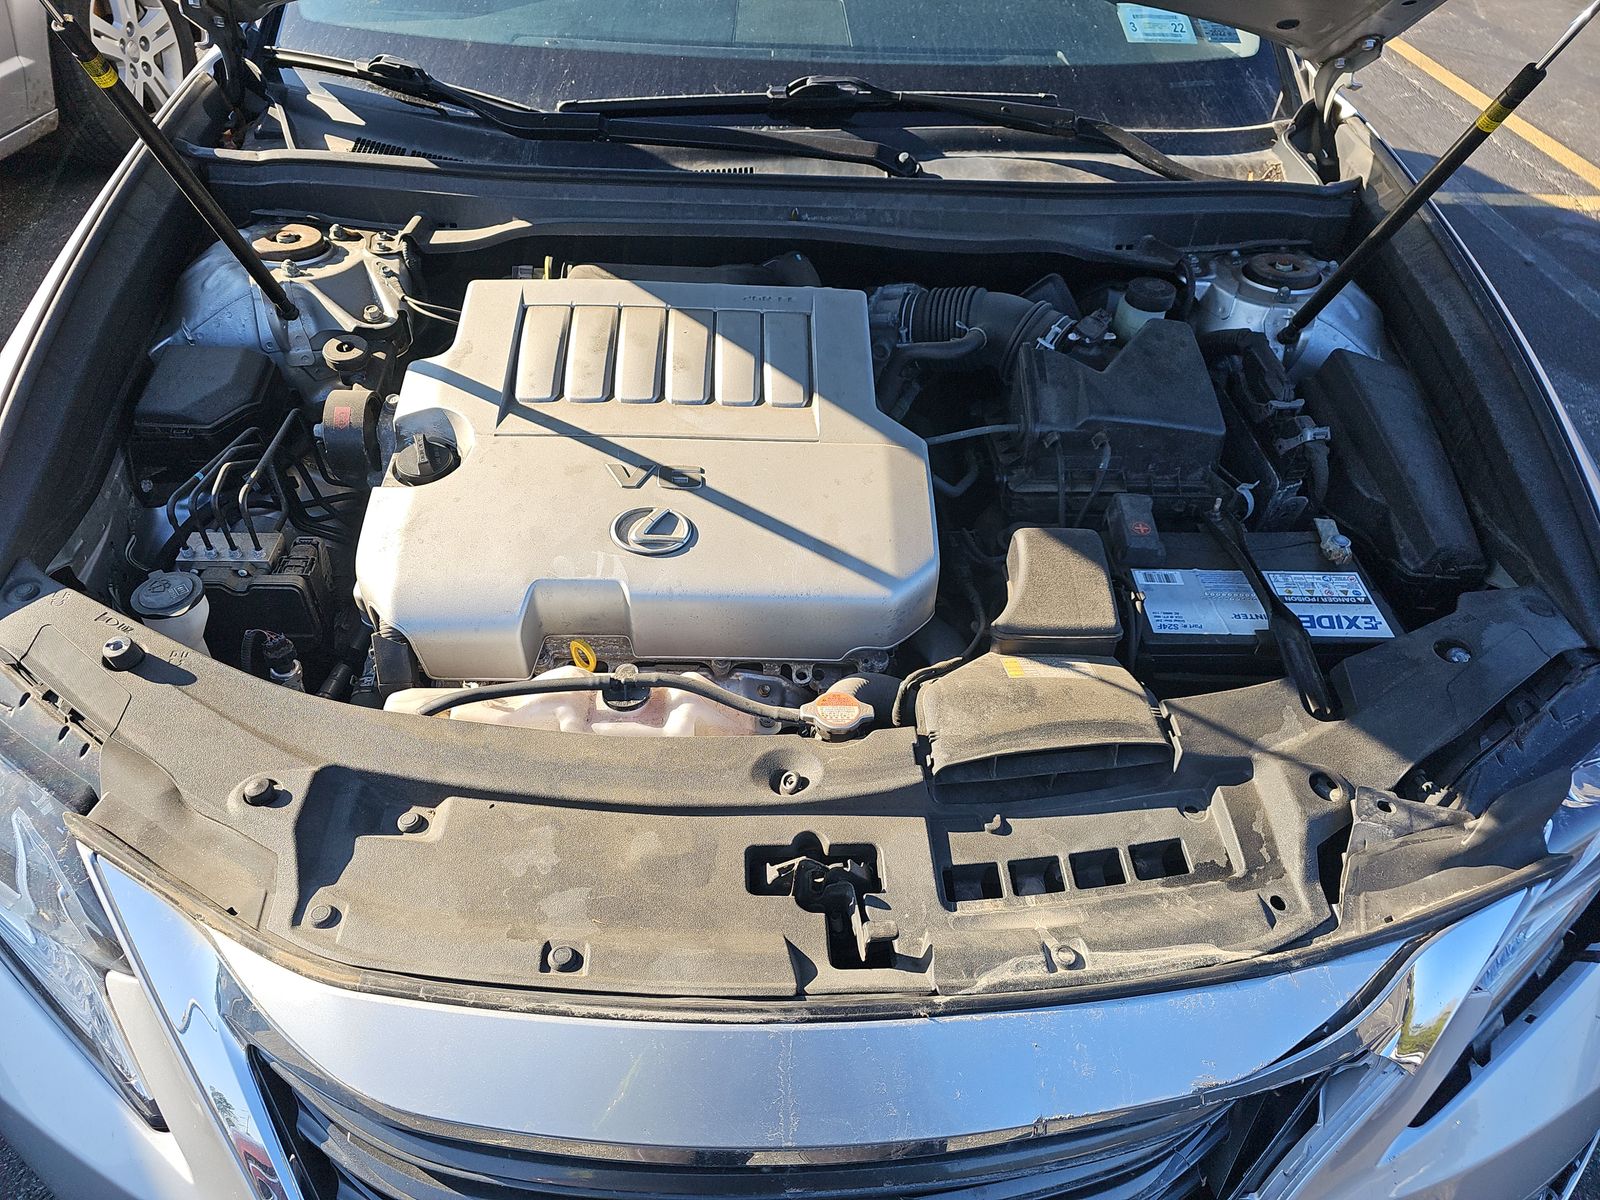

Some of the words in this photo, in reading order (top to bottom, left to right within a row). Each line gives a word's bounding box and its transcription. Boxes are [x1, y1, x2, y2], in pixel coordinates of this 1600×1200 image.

[1170, 22, 1186, 33] 22
[605, 463, 706, 490] V6
[1319, 596, 1359, 604] DANGER
[1157, 623, 1179, 631] S24F
[1297, 614, 1383, 631] EXIDE
